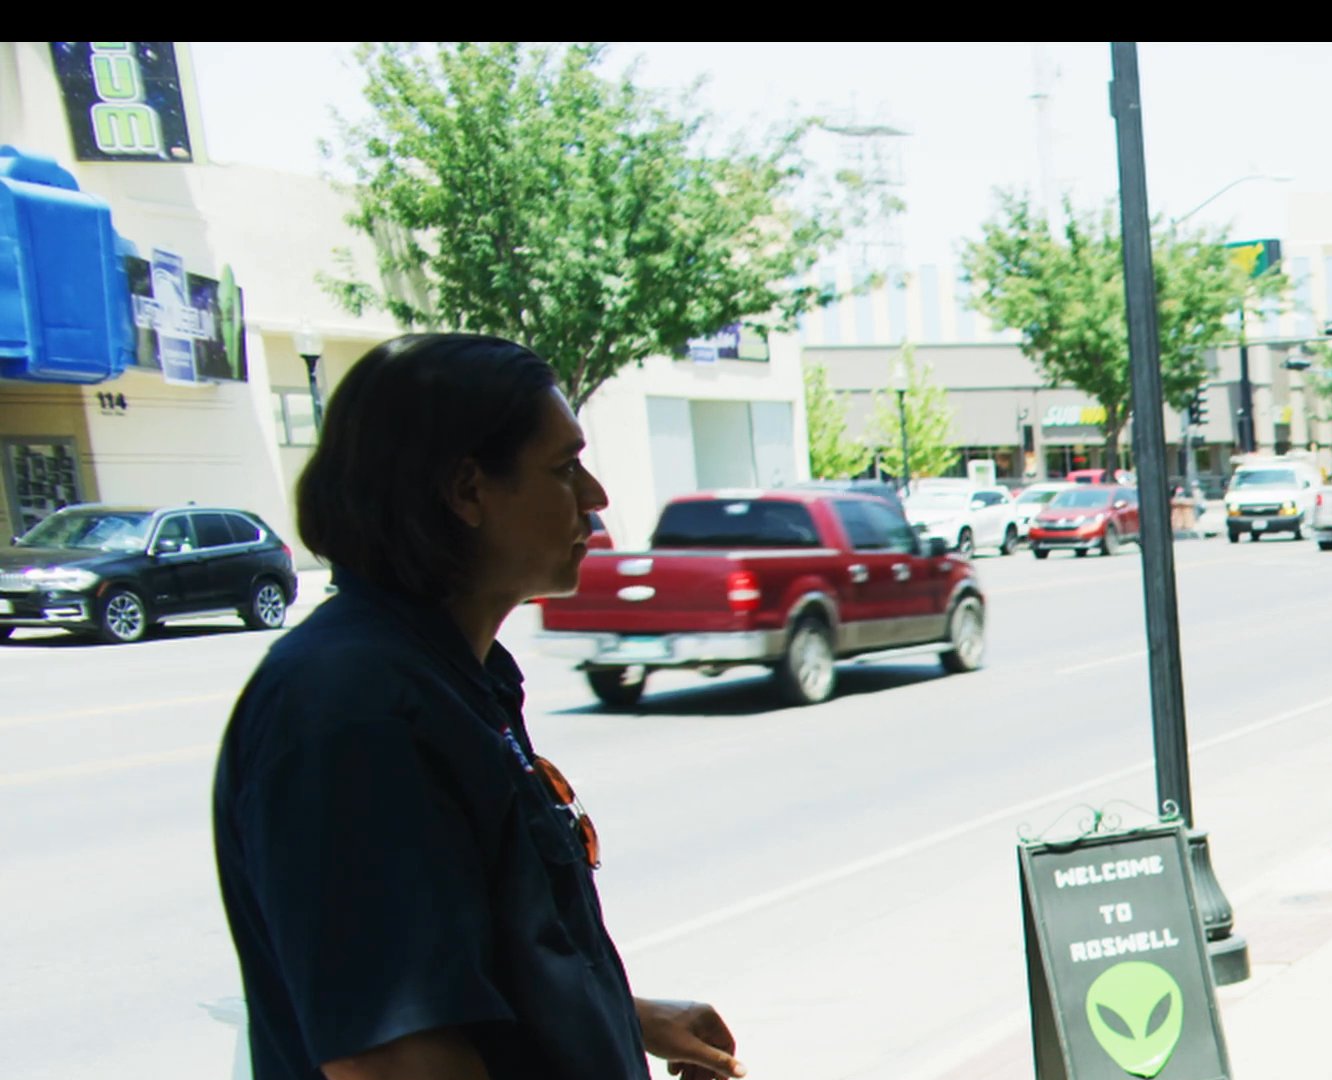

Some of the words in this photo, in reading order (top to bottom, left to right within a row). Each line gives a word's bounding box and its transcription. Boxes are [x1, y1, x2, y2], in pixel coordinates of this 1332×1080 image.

[96, 390, 128, 410] 114
[1041, 404, 1110, 427] SUBWA
[1054, 855, 1164, 889] WELCOME
[1099, 902, 1133, 924] TO
[1069, 927, 1180, 962] ROSWELL
